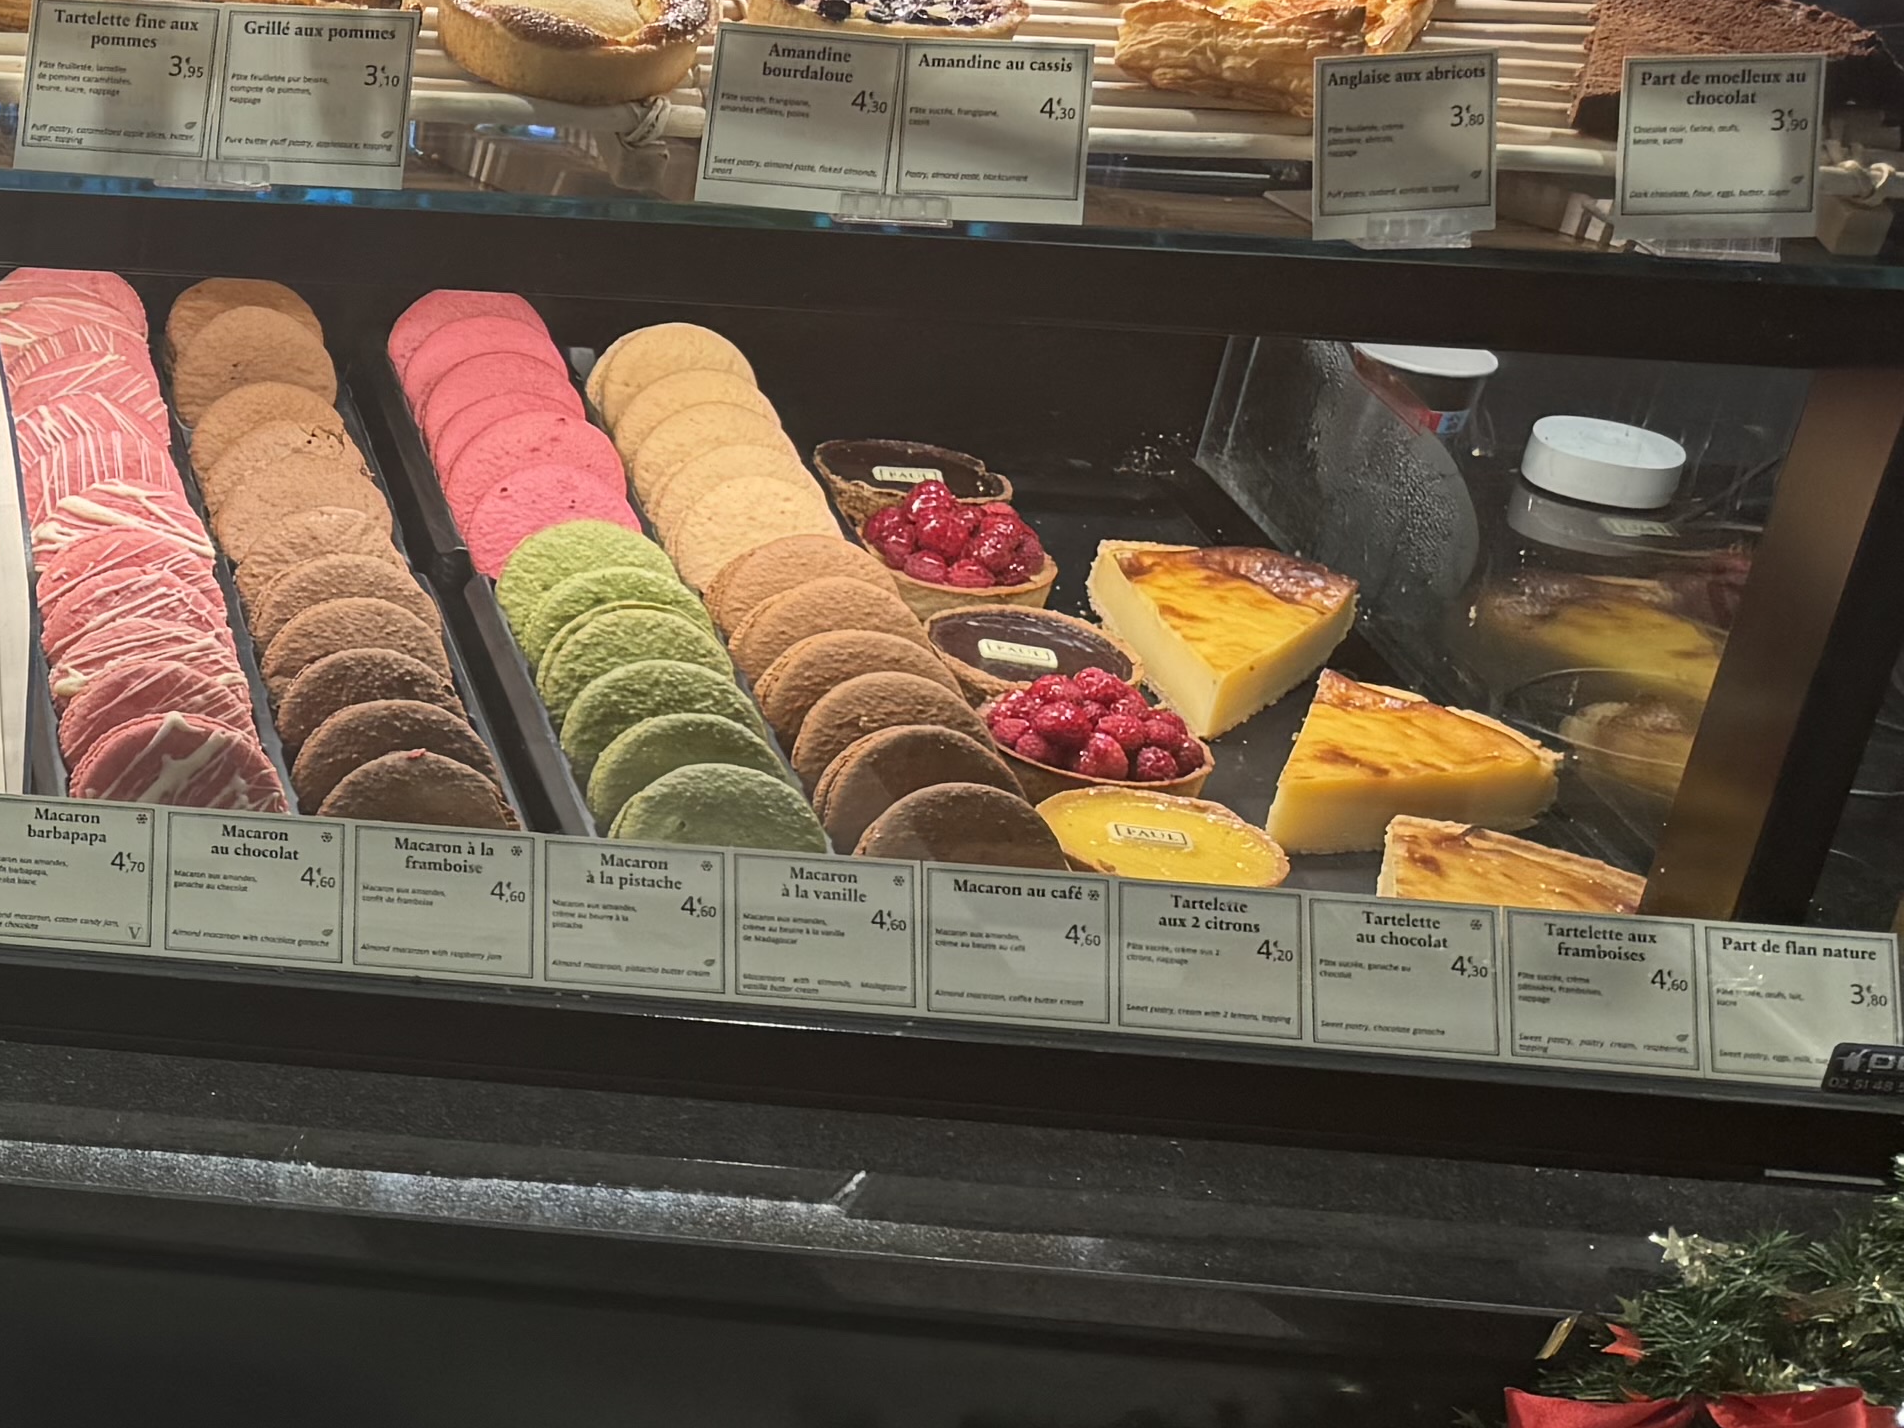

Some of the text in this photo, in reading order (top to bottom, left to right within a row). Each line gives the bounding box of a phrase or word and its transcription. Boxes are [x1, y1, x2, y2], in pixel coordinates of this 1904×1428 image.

[242, 19, 396, 42] Grillé aux pommes
[917, 52, 1073, 73] Amandine au cassis
[1326, 63, 1486, 90] Anglaise aux abricots
[33, 805, 101, 825] Macaron
[26, 822, 107, 847] barbapapa
[393, 835, 494, 857] Macaron à la
[404, 854, 483, 874] framboise
[599, 851, 669, 871] Macaron
[584, 869, 683, 891] à la pistache
[952, 877, 1083, 901] Macaron au café
[1360, 909, 1441, 930] Tartelette
[1355, 929, 1449, 949] au chocolat
[1720, 935, 1877, 961] Part de flan nature
